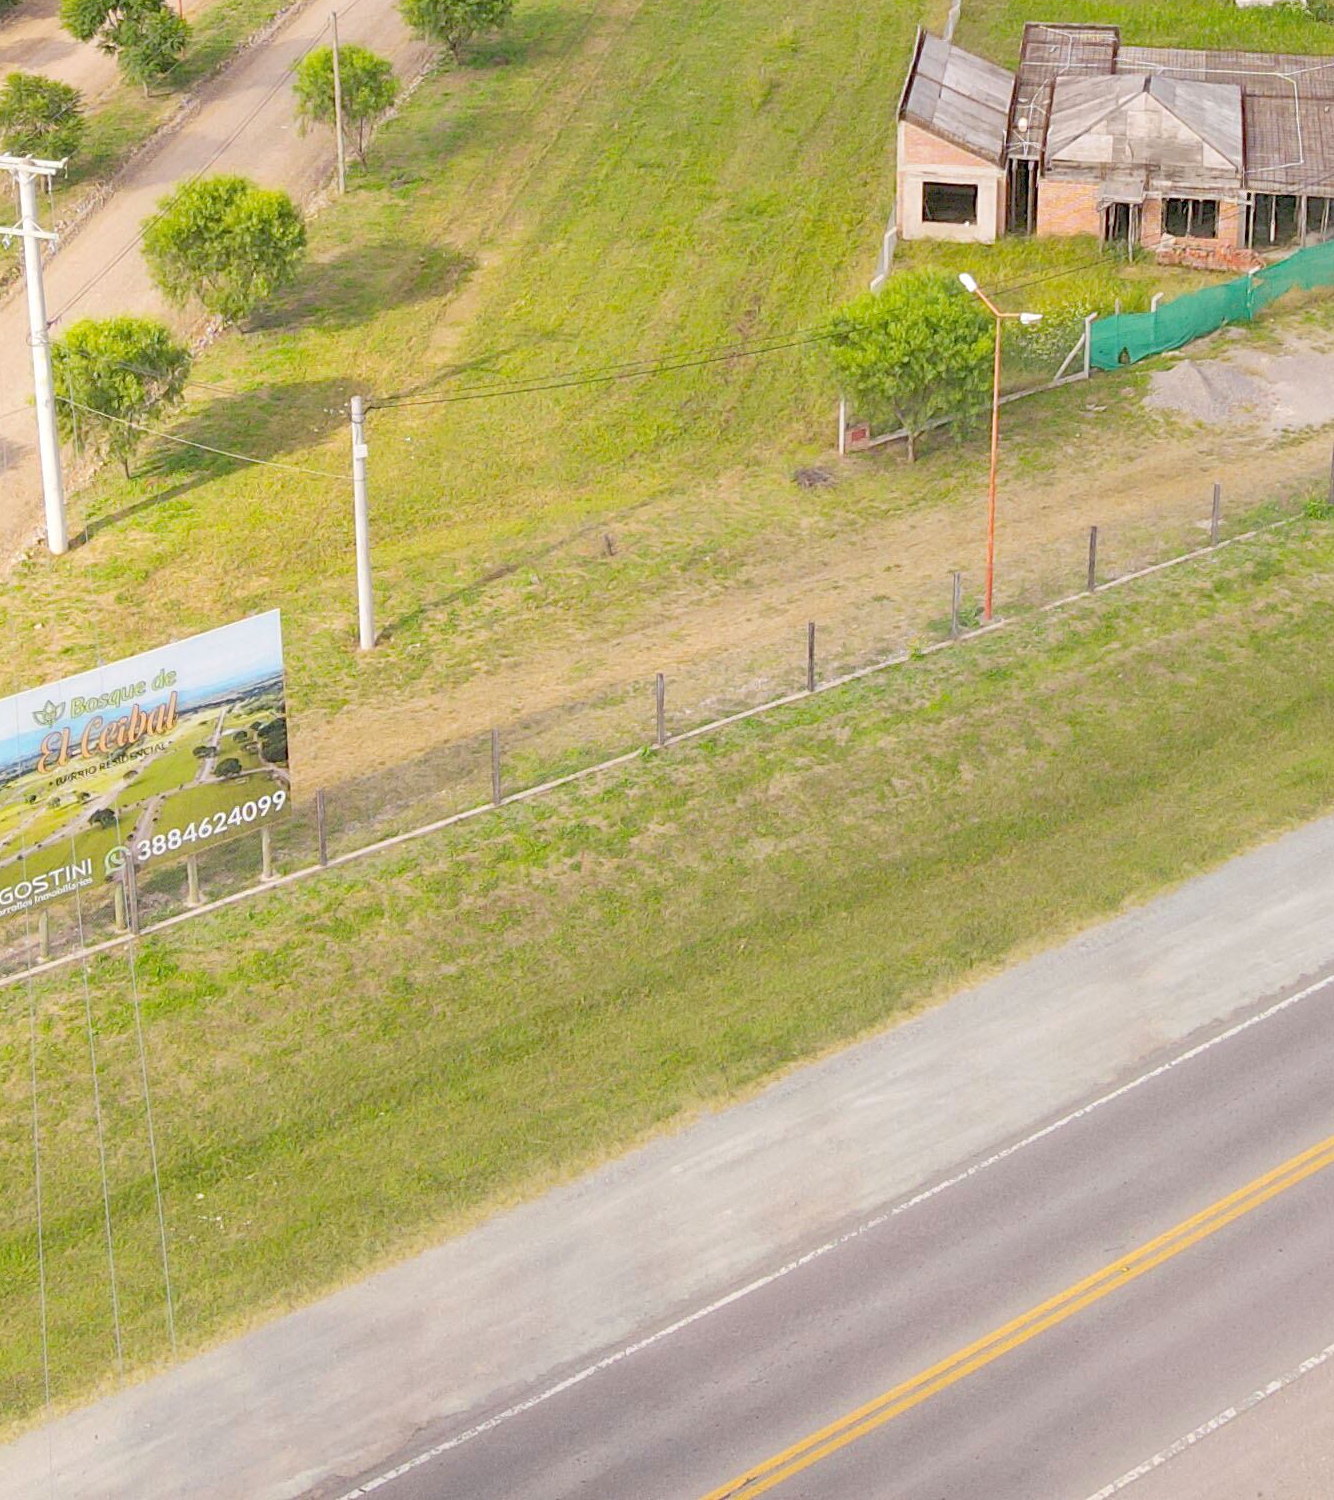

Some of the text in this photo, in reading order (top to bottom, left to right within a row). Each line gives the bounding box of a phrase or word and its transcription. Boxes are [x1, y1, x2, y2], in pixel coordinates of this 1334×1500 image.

[70, 668, 177, 719] Bosque de
[37, 690, 179, 774] El Ceibal
[137, 789, 287, 862] 3884624099
